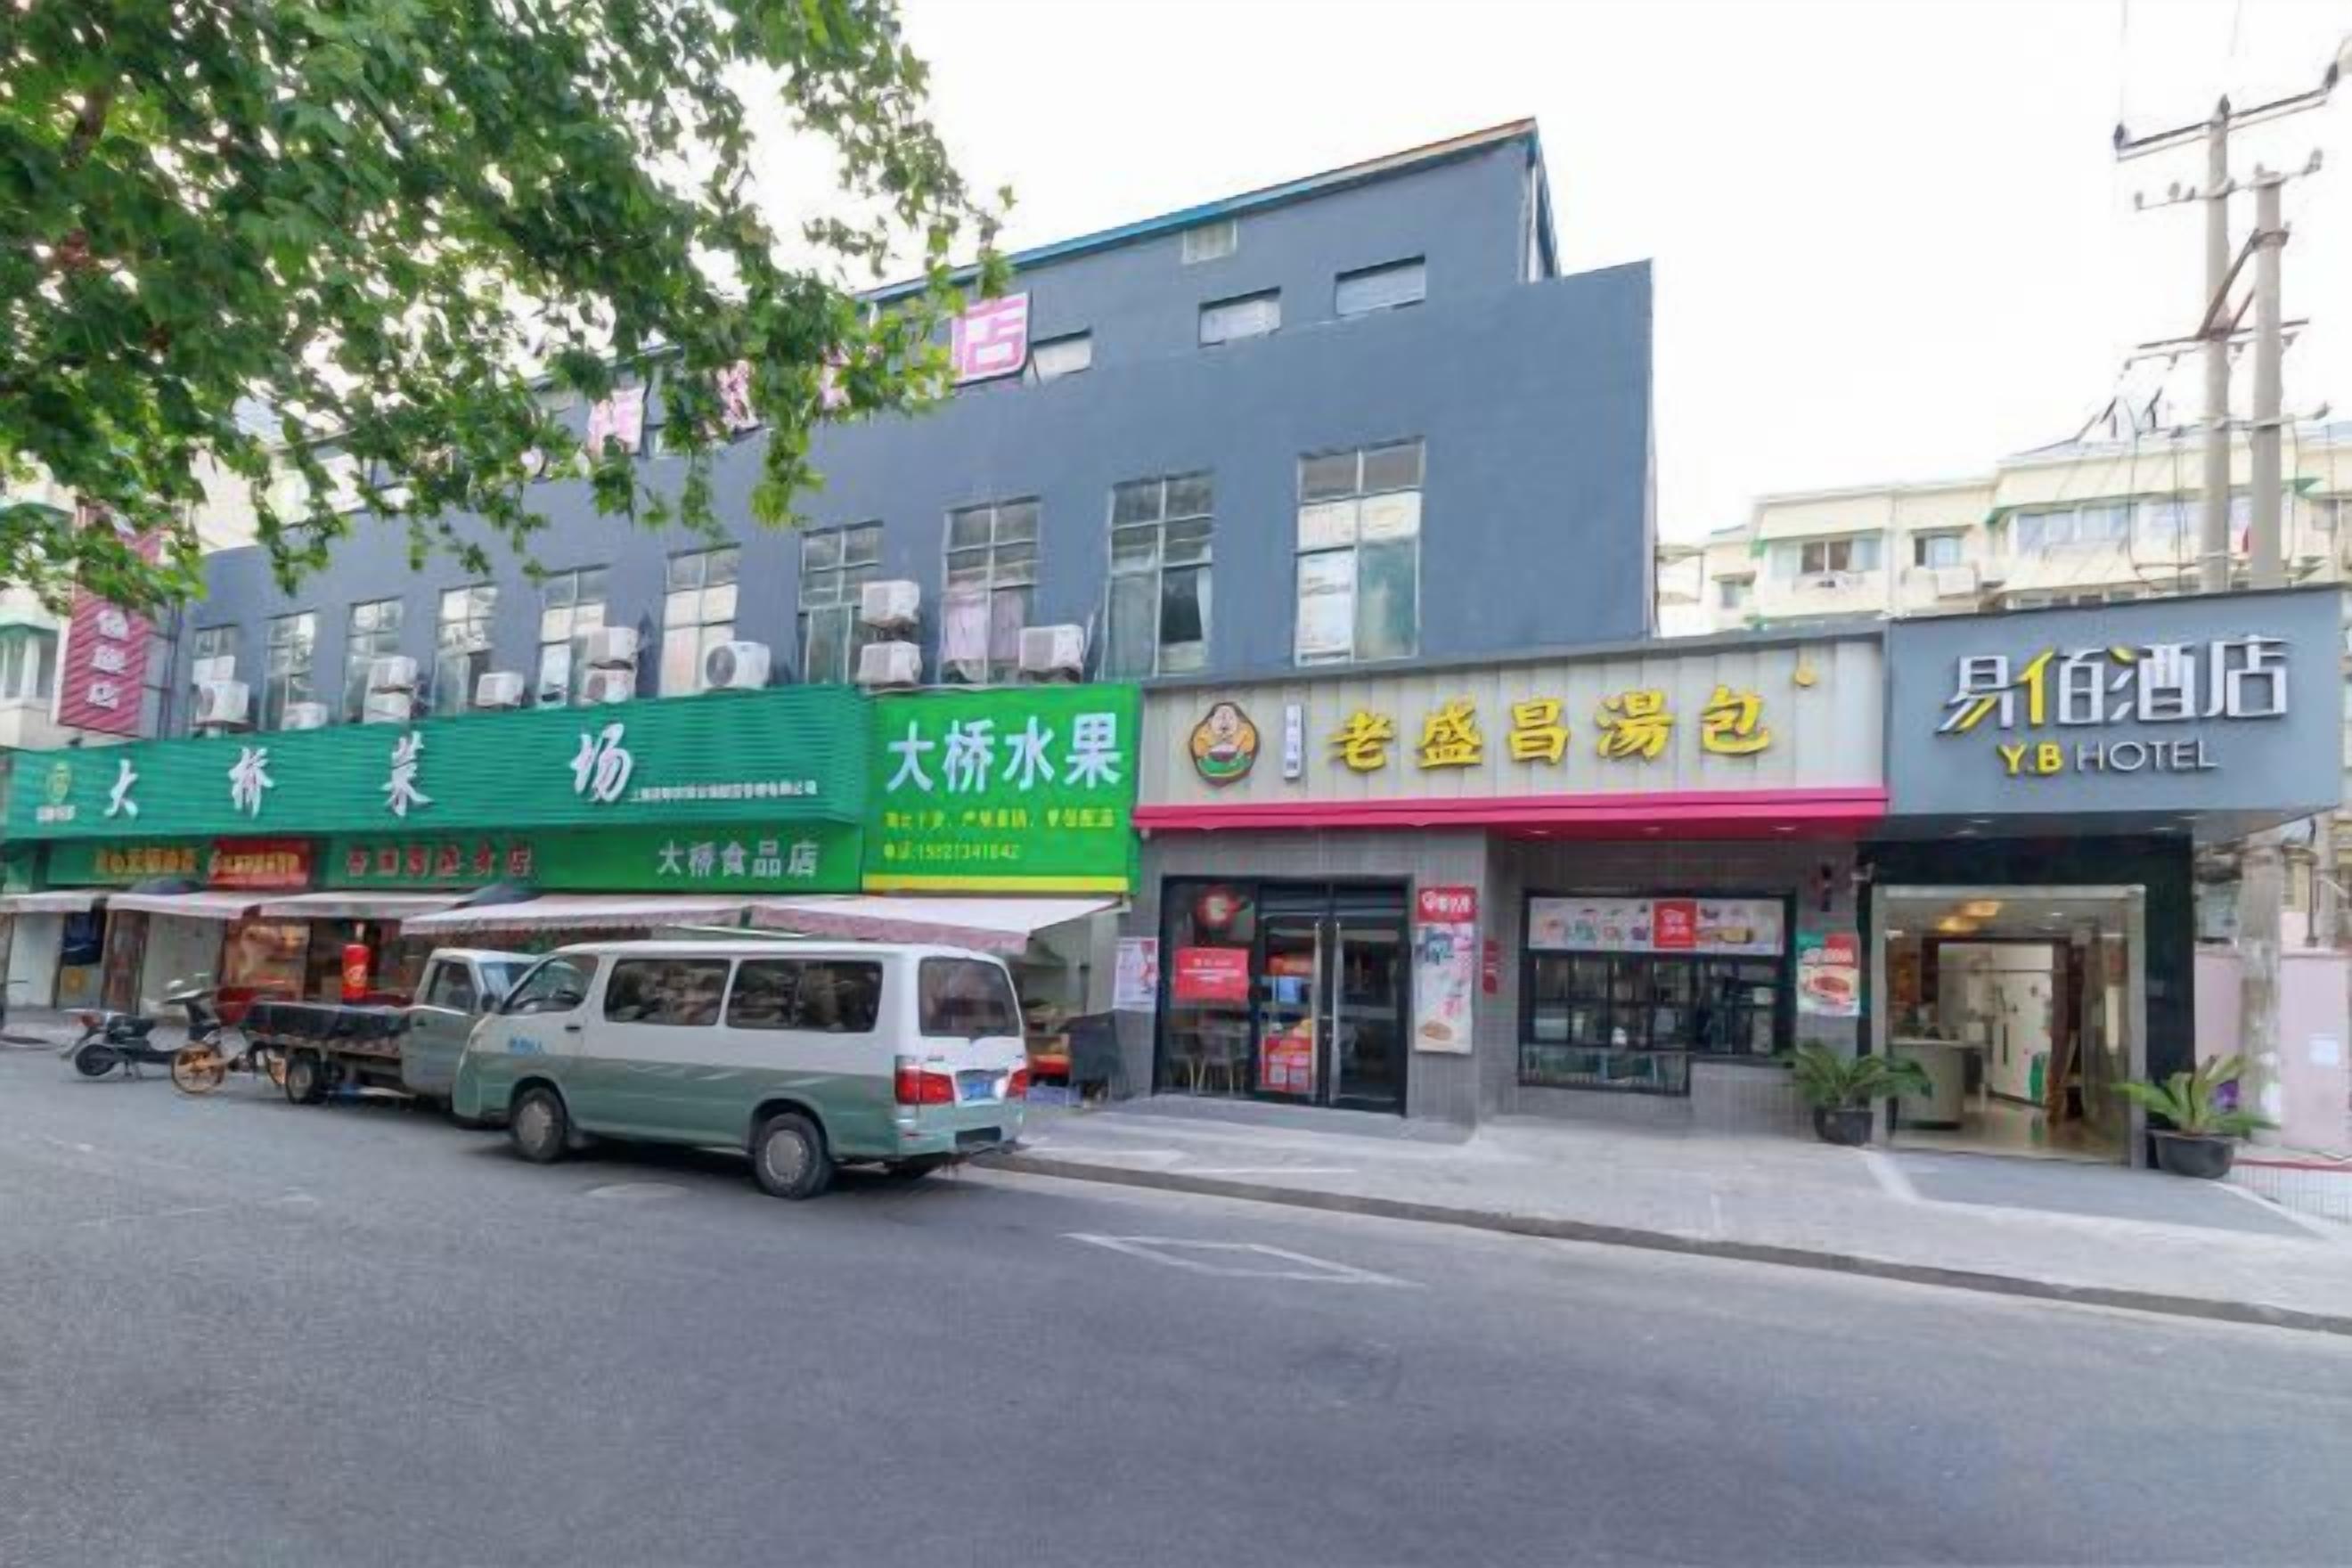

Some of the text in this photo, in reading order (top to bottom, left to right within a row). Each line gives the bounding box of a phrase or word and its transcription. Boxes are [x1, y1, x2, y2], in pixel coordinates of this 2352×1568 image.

[1937, 635, 2289, 733] 易佰酒店
[886, 712, 1123, 794] 大桥水果
[1331, 685, 1773, 772] 老盛昌湯包
[2076, 739, 2220, 774] HOTEL
[104, 723, 633, 819] 大桥菜场
[656, 839, 819, 878] 大桥食品店
